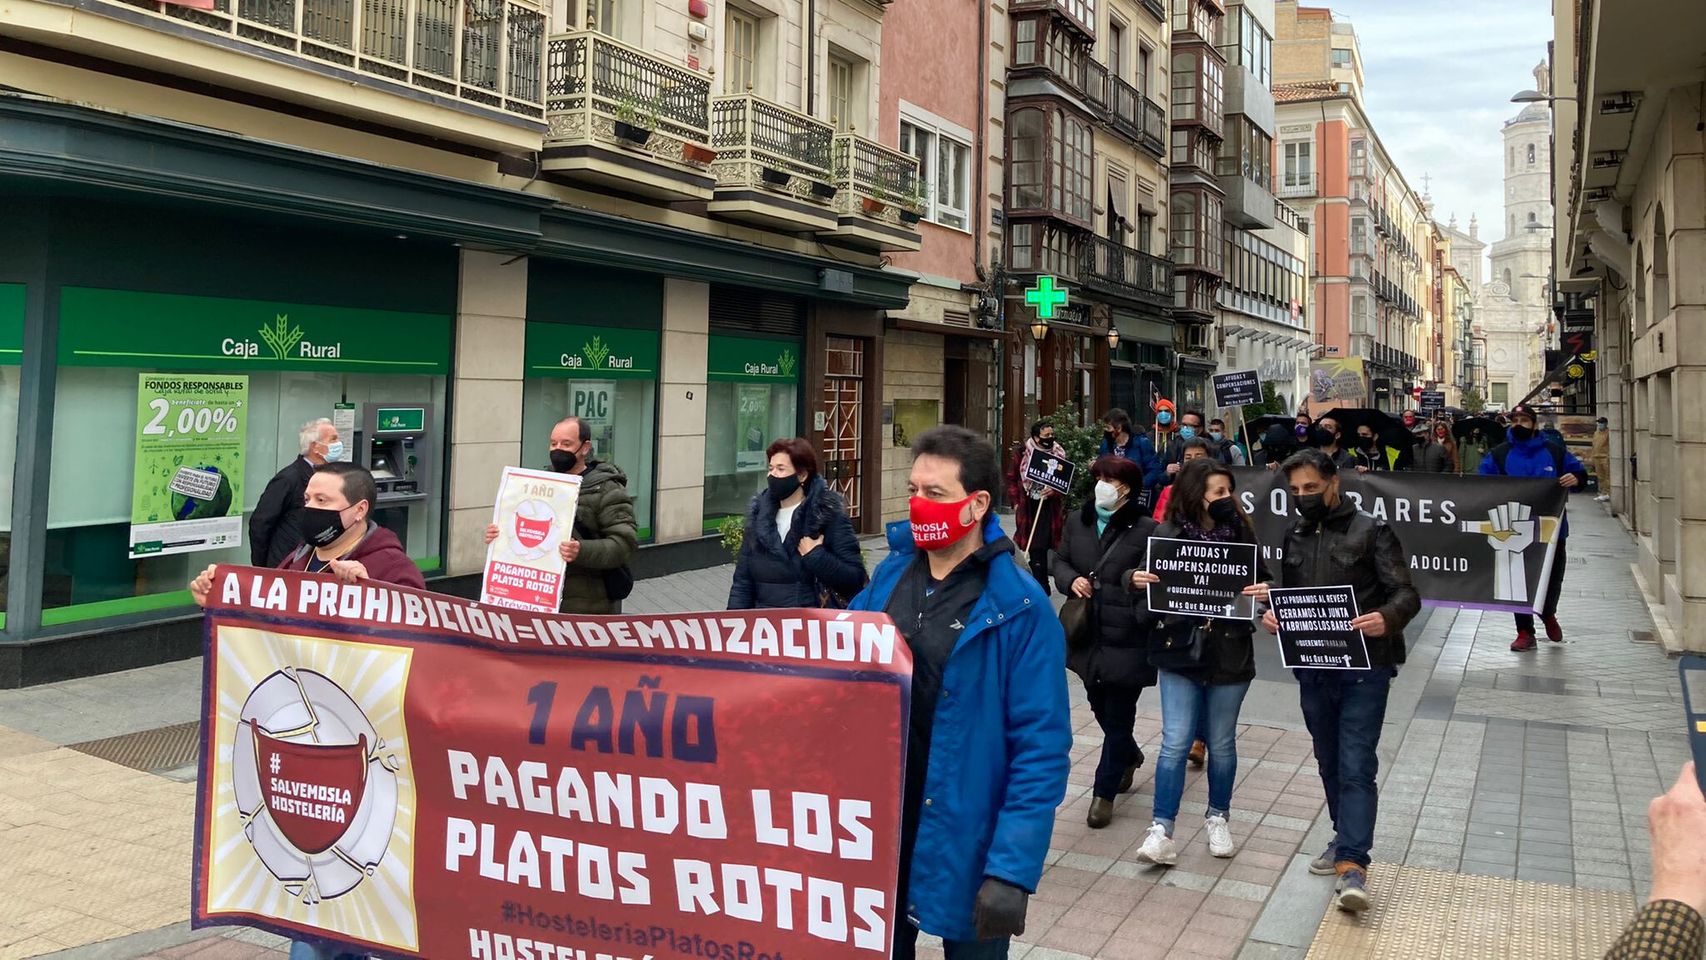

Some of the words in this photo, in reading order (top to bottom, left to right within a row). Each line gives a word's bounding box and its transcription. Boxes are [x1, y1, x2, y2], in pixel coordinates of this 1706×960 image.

[222, 338, 259, 359] Caja
[300, 341, 341, 358] Rural
[560, 353, 582, 369] Caja
[608, 355, 633, 369] Rural
[744, 362, 760, 376] Caja
[760, 363, 778, 374] Rural
[145, 381, 181, 390] FONDOS
[183, 381, 243, 390] RESPONSABLES
[575, 390, 608, 417] PAC
[142, 398, 238, 438] 2,00%
[531, 483, 554, 498] AÑO
[910, 521, 949, 532] EMOSLA
[1176, 545, 1220, 559] ¡AYUDAS
[1222, 548, 1229, 559] Y
[1155, 559, 1248, 577] COMPENSACIONES
[1410, 554, 1469, 572] ADOLID
[494, 562, 538, 580] PAGANDO
[539, 571, 558, 584] LOS
[1193, 574, 1210, 586] YA!
[222, 572, 242, 606] A
[250, 574, 288, 611] LA
[491, 573, 525, 588] PLATOS
[526, 581, 555, 594] ROTOS
[1319, 594, 1326, 603] AL
[1279, 607, 1317, 619] CERRAMOS
[1317, 607, 1327, 618] LA
[1328, 607, 1349, 618] JUNTA
[1280, 621, 1286, 632] Y
[1286, 621, 1318, 632] ABRIMOS
[1318, 621, 1332, 631] LOS
[1331, 620, 1354, 632] BARES
[526, 680, 558, 746] 1
[570, 675, 718, 764] AÑO
[270, 777, 352, 806] SALVEMOSLA
[271, 795, 346, 824] HOSTELERÍA
[447, 749, 728, 840] PAGANDO
[751, 789, 874, 861] LOS
[445, 816, 652, 906] PLATOS
[673, 858, 887, 953] ROTOS
